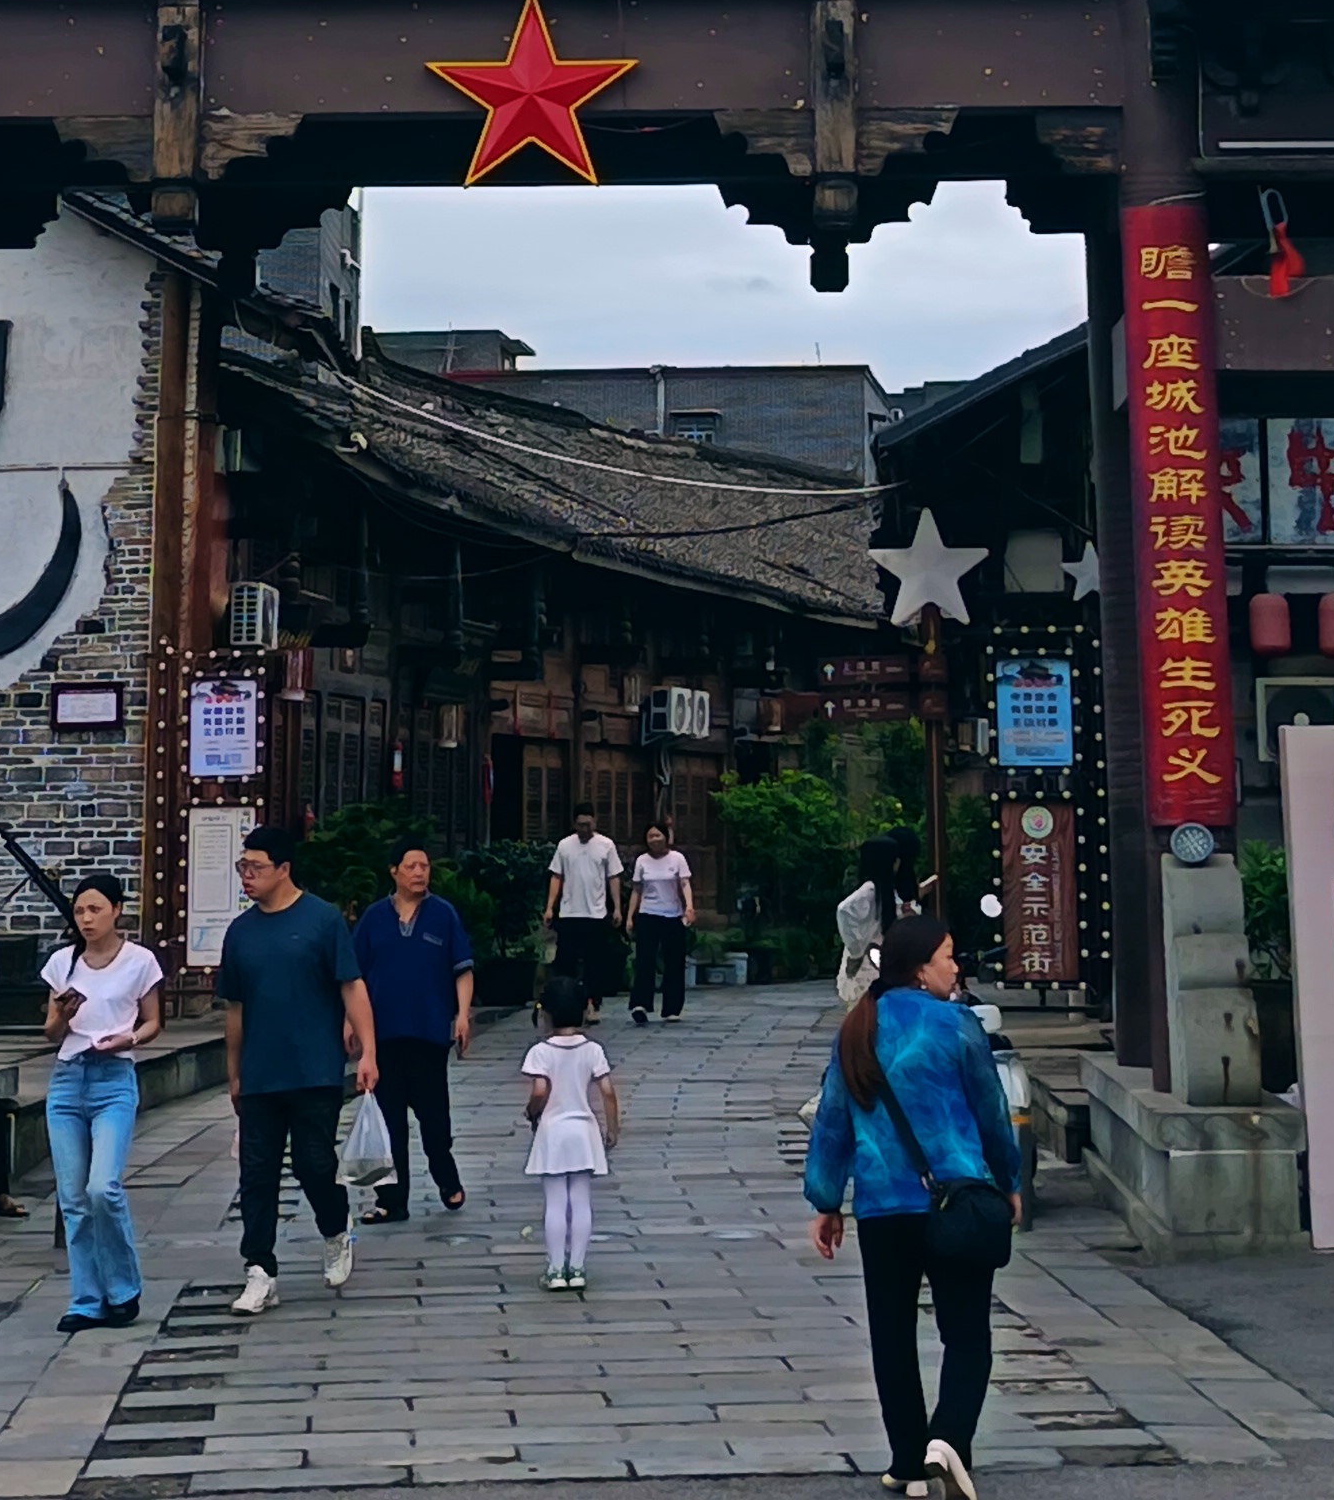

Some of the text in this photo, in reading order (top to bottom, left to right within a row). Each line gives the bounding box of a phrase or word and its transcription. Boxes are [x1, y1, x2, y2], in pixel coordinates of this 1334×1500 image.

[1140, 245, 1223, 785] 瞻一座城池解读英雄生死义
